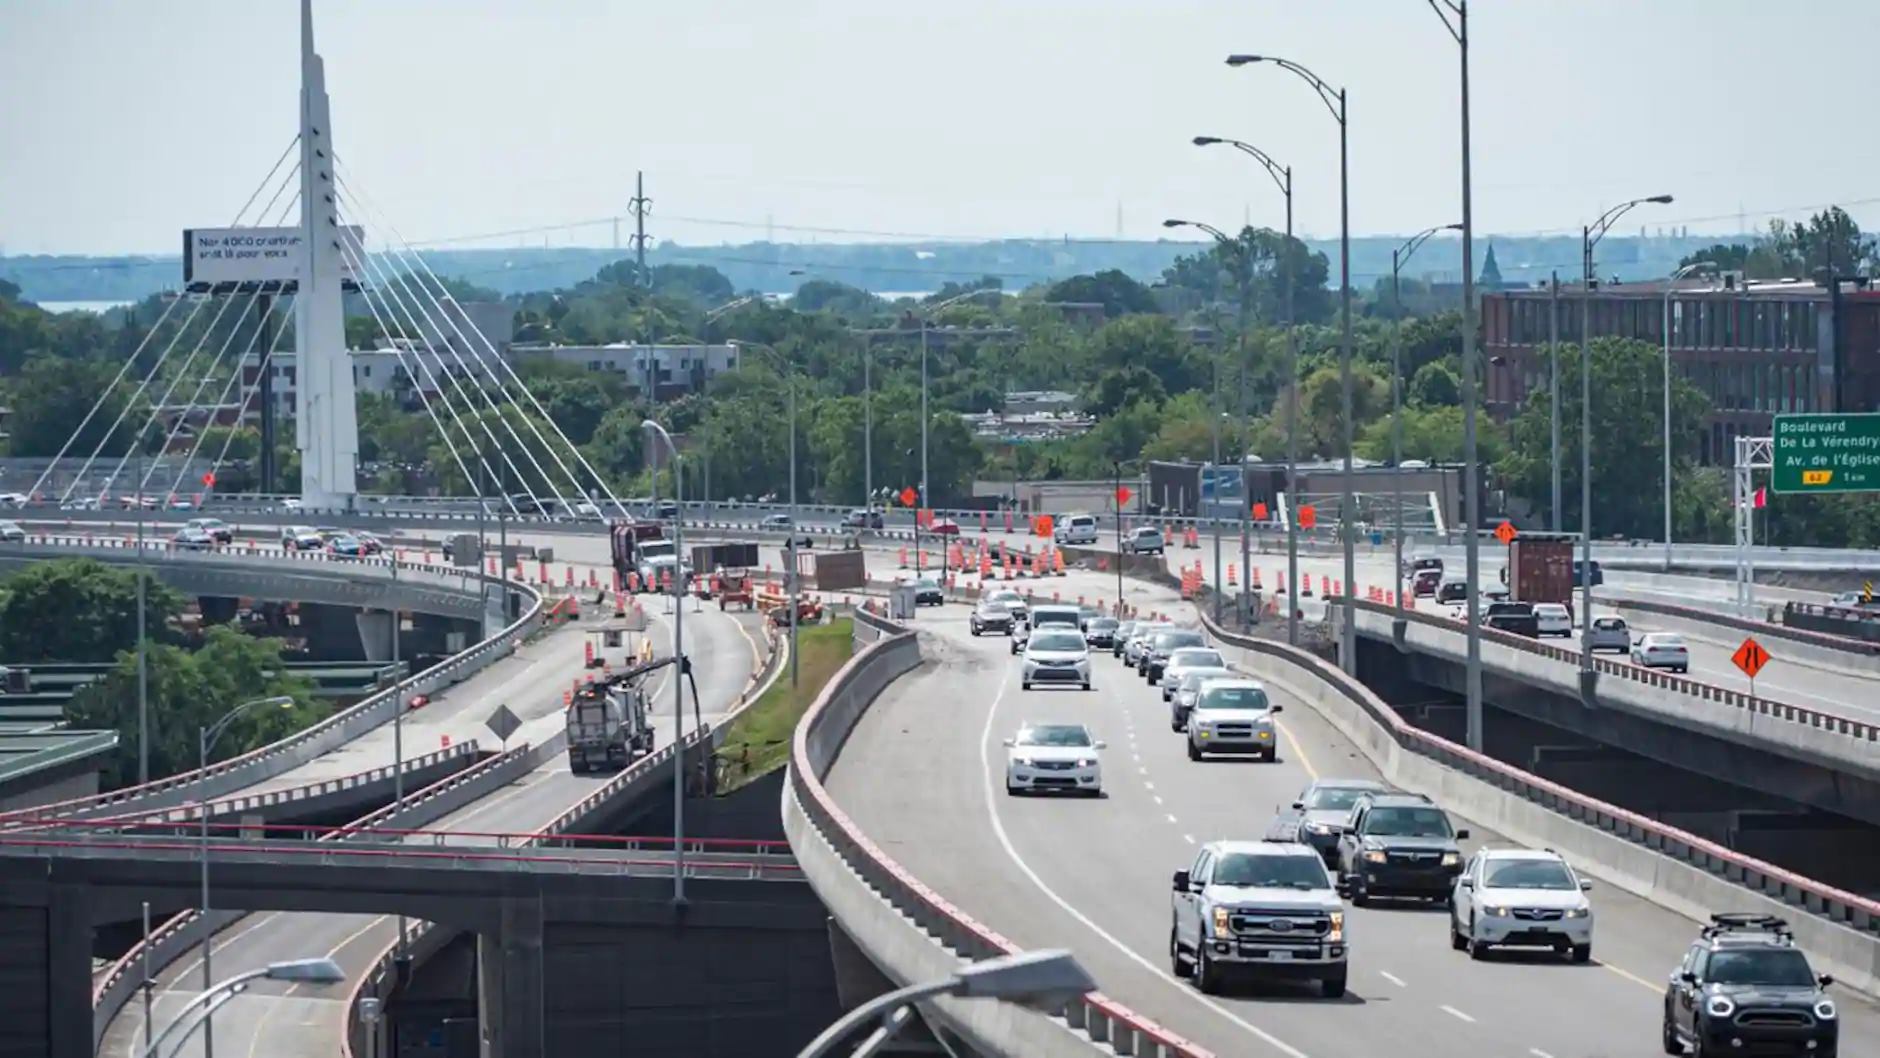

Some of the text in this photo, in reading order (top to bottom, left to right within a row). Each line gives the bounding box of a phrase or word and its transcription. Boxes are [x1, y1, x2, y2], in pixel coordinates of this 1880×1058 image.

[1780, 420, 1846, 433] Boulevard
[1780, 434, 1880, 449] De La Vérendry
[1786, 455, 1806, 466] Av.
[1811, 454, 1828, 465] de
